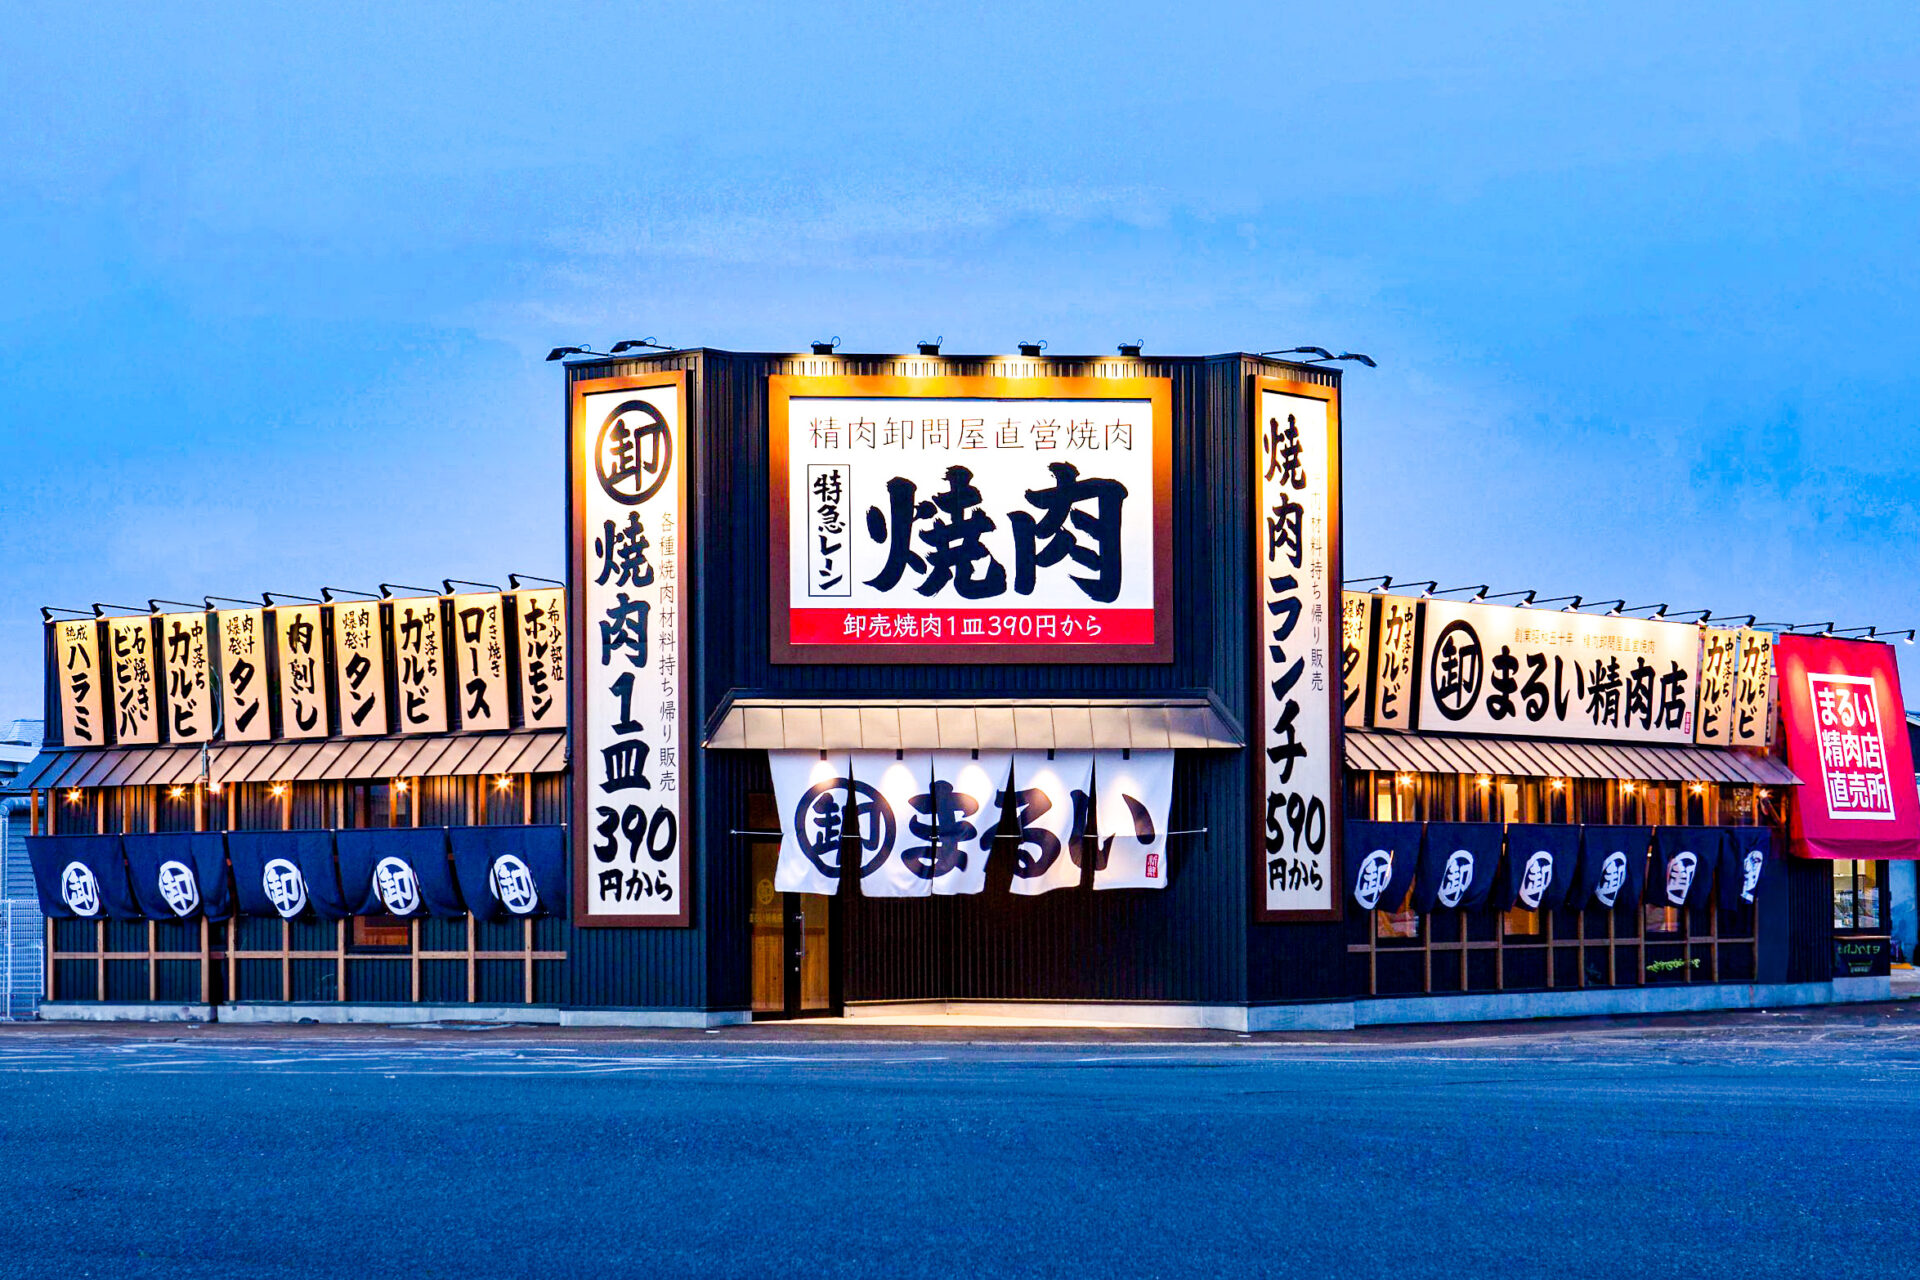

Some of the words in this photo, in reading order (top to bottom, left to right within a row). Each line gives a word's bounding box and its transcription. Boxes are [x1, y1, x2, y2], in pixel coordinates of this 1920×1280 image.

[604, 415, 664, 494] 卸
[808, 417, 1132, 451] 精肉卸問屋直営焼肉
[813, 469, 846, 591] 特急レーン
[862, 461, 1128, 603] 焼肉
[423, 608, 439, 677] 中落ち
[486, 605, 502, 678] すき焼き
[843, 612, 1102, 639] 卸売焼肉1皿390円から
[1263, 413, 1307, 785] 焼肉ランチ
[67, 643, 92, 741] ハラミ
[114, 626, 138, 737] ビビンバ
[131, 626, 150, 721] 石焼き
[168, 621, 198, 737] カルビ
[191, 621, 206, 690] 中落ち
[229, 658, 259, 733] タン
[345, 652, 376, 727] タン
[400, 607, 430, 724] カルビ
[458, 607, 492, 719] ロース
[524, 599, 553, 721] ホルモン
[658, 511, 677, 793] 各種焼肉材料持ち帰り販売
[1381, 605, 1403, 720] カルビ
[1435, 632, 1480, 711] 卸
[1486, 645, 1688, 731] まるい精肉店
[1703, 635, 1725, 738] カルビ
[1739, 636, 1761, 739] カルビ
[1818, 687, 1875, 727] まるい
[1822, 729, 1882, 769] 精肉店
[593, 804, 677, 863] 390
[901, 780, 1156, 880] まるい
[1265, 791, 1326, 855] 590
[1827, 771, 1888, 810] 直売所
[598, 869, 673, 903] 円から
[1268, 857, 1323, 892] 円から
